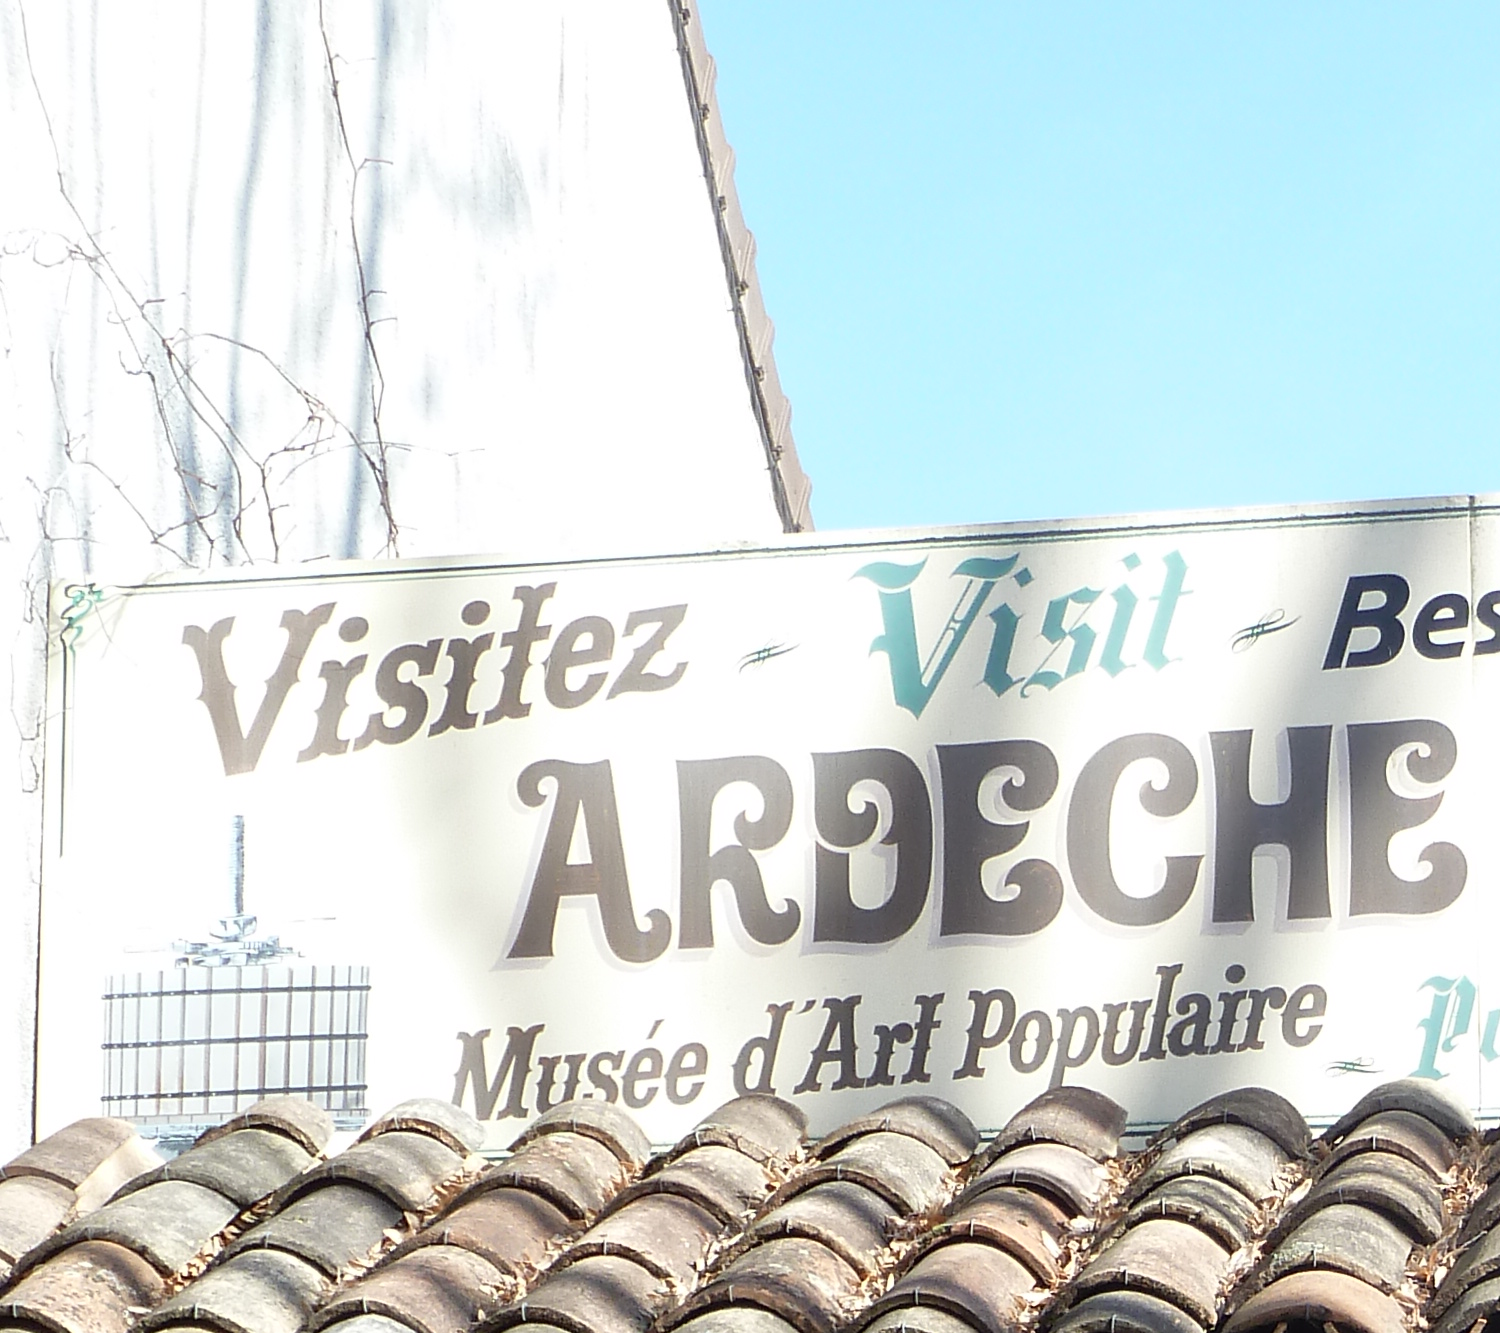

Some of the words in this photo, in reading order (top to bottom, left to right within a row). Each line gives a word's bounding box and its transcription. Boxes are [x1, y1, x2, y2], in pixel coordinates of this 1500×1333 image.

[182, 582, 688, 776] Visitez
[849, 548, 1194, 719] Visit
[506, 719, 1467, 964] ARDECHE
[453, 1019, 708, 1121] Musée
[731, 995, 942, 1095] d'Art
[955, 964, 1327, 1086] Populaire
